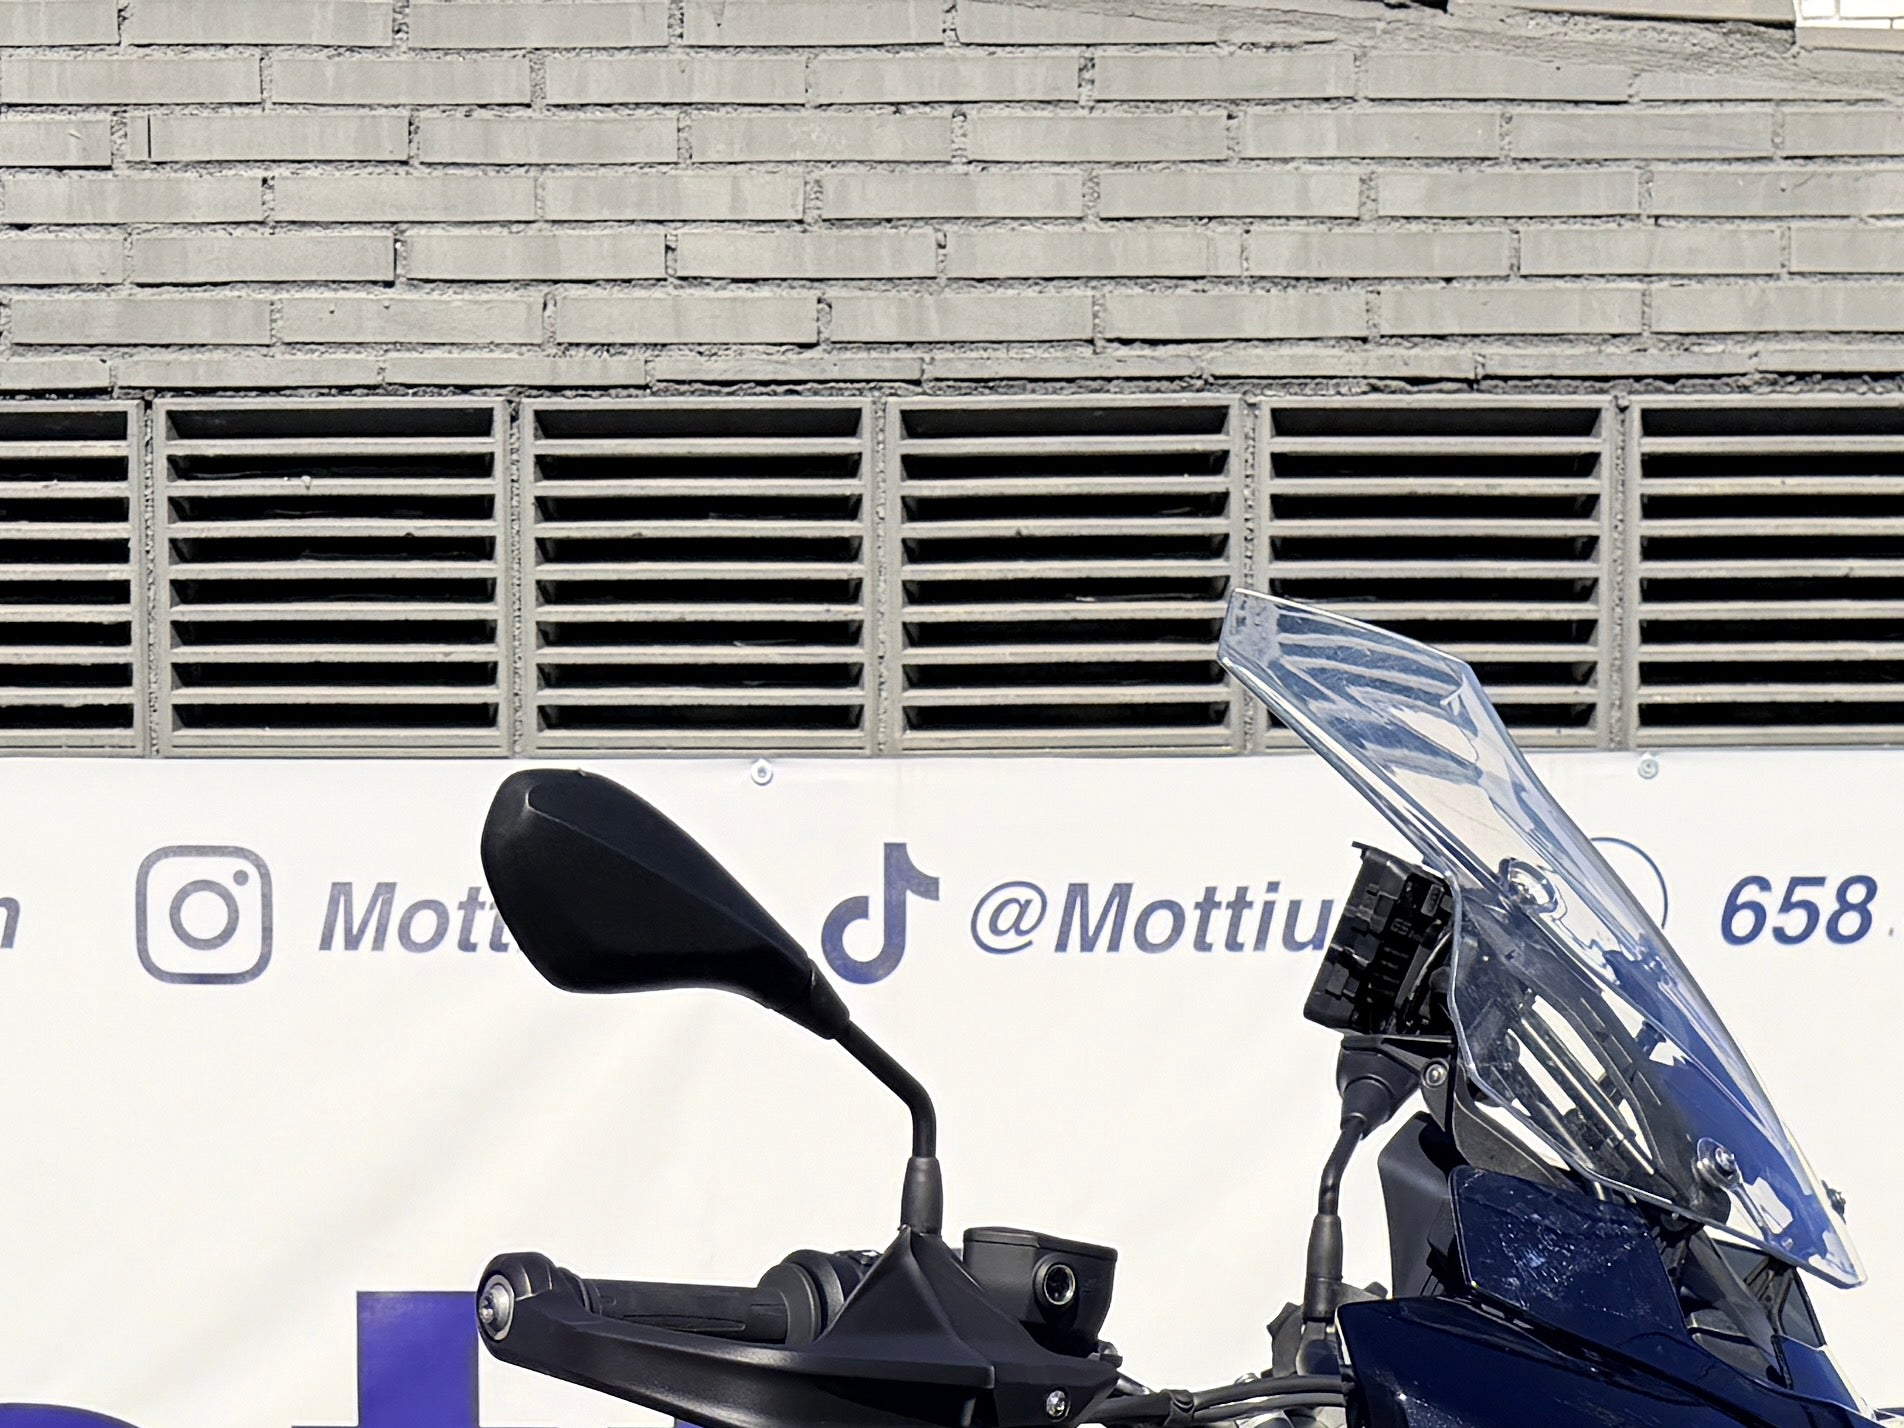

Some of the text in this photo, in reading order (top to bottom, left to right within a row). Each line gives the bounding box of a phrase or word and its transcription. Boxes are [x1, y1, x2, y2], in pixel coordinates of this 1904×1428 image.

[318, 881, 512, 954] Mott
[970, 880, 1335, 955] @Mottiu
[1720, 874, 1879, 947] 658
